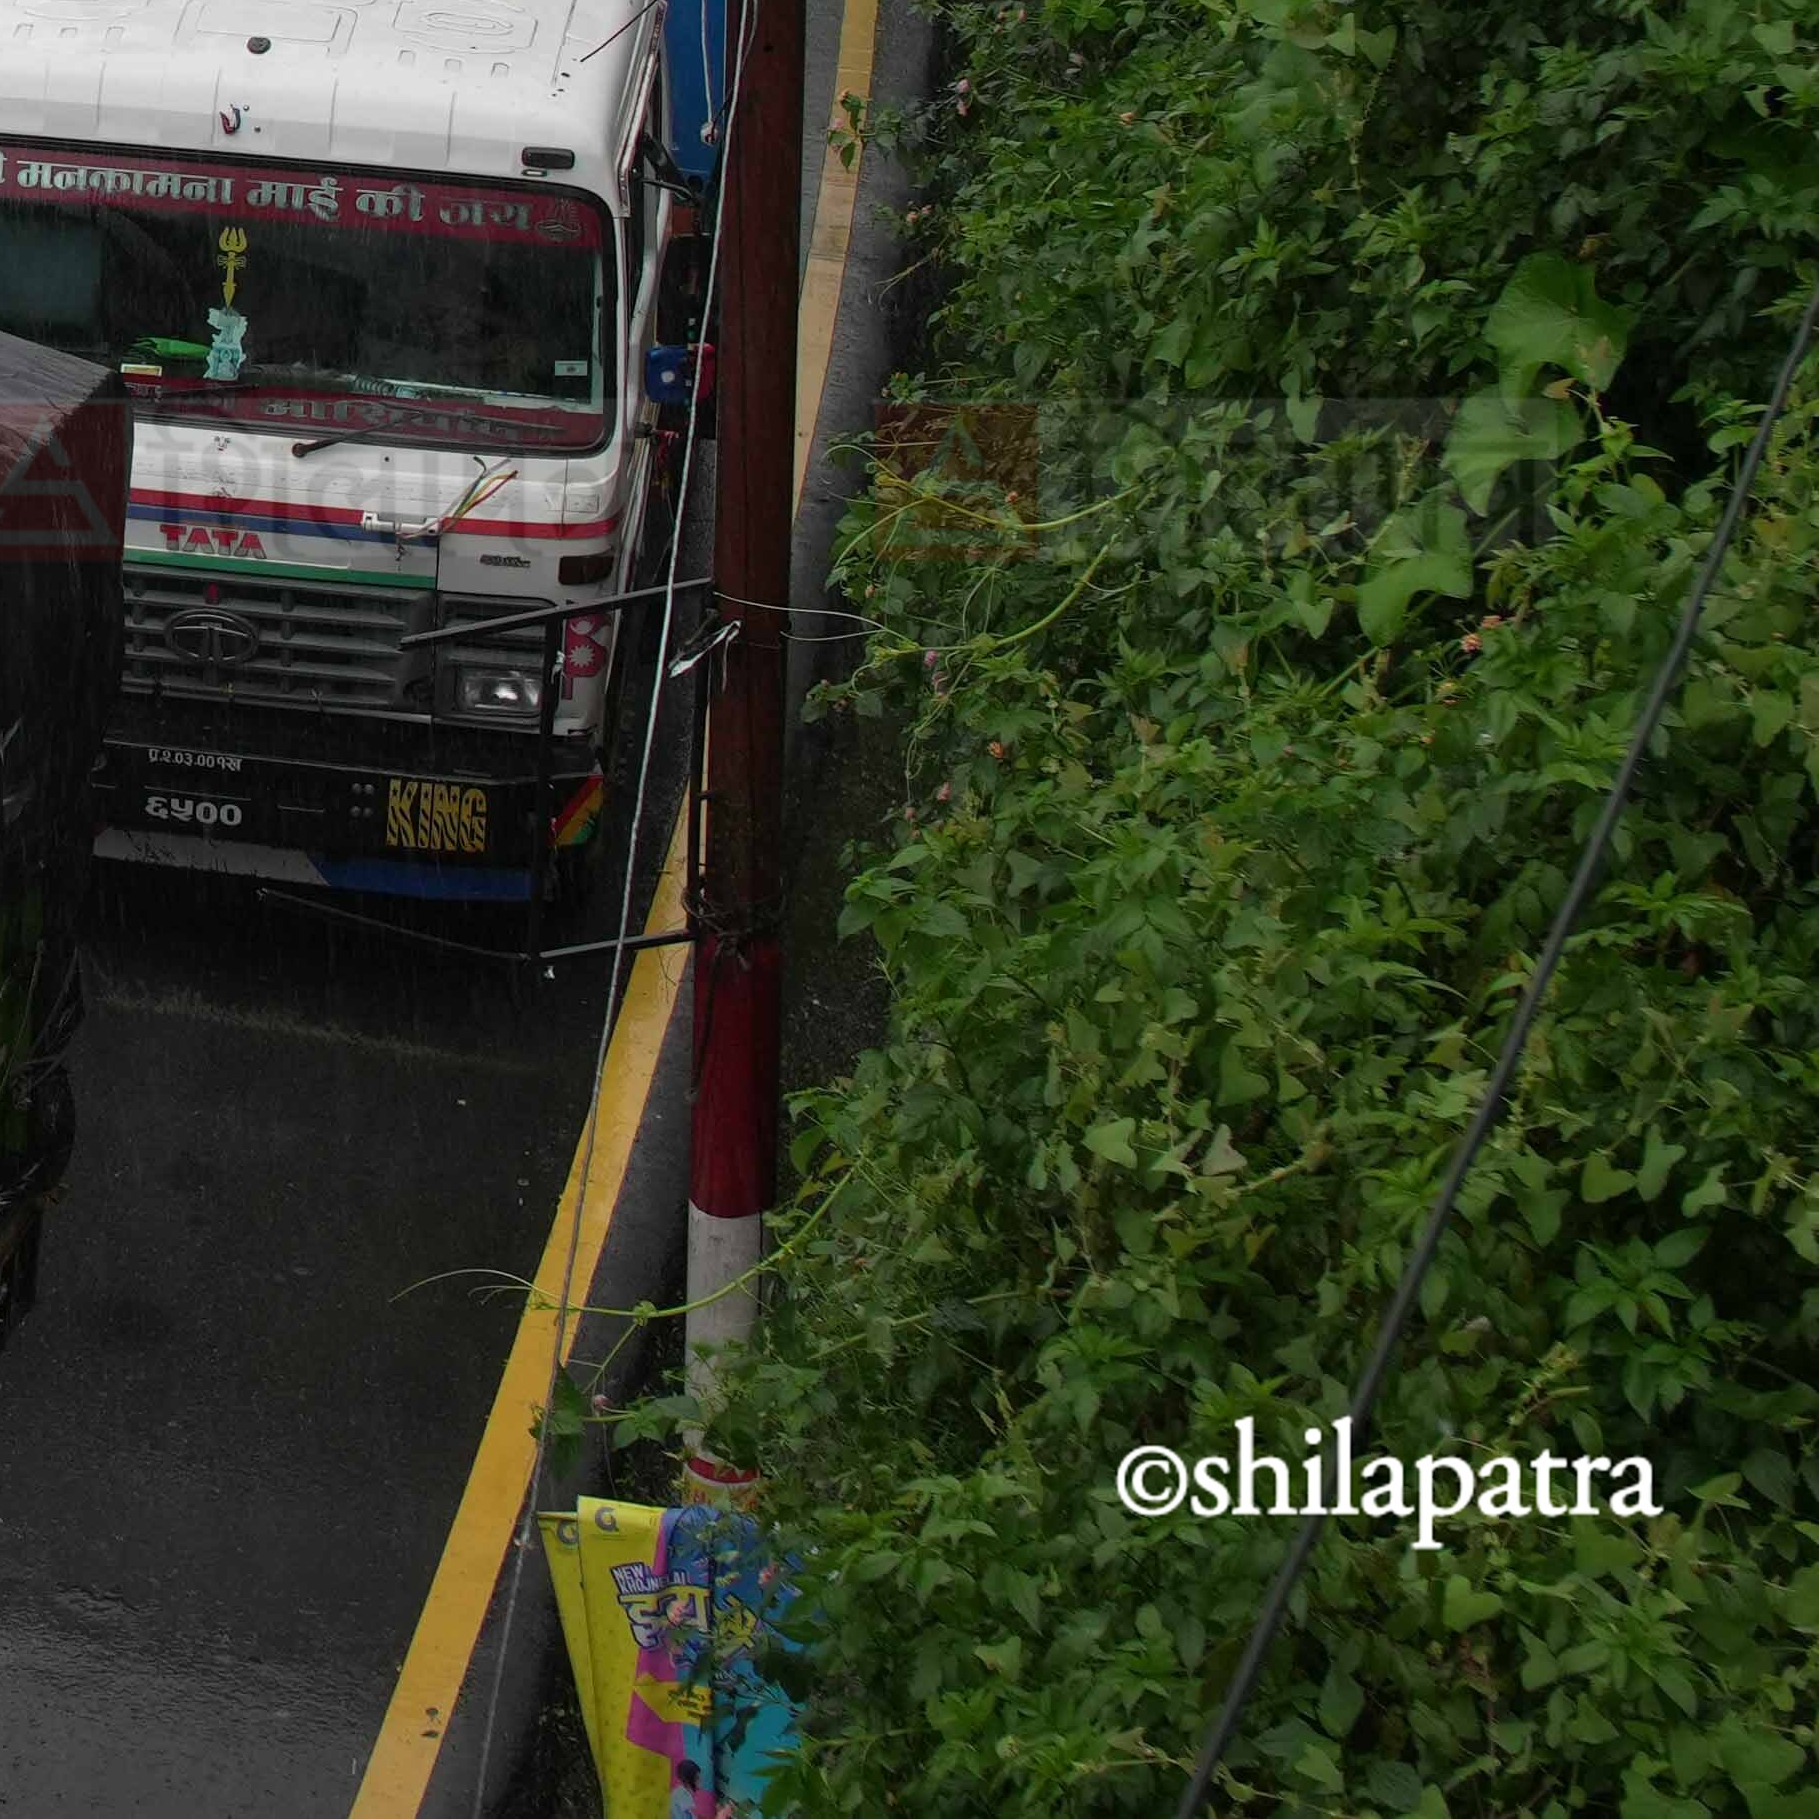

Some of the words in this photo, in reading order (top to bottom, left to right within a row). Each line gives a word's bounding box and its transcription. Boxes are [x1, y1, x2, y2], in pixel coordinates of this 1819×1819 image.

[16, 160, 235, 206] मनकामना
[354, 183, 425, 223] की
[159, 524, 268, 560] TATA
[144, 794, 243, 827] ६५००
[385, 778, 488, 853] KING
[613, 1563, 645, 1581] NEW
